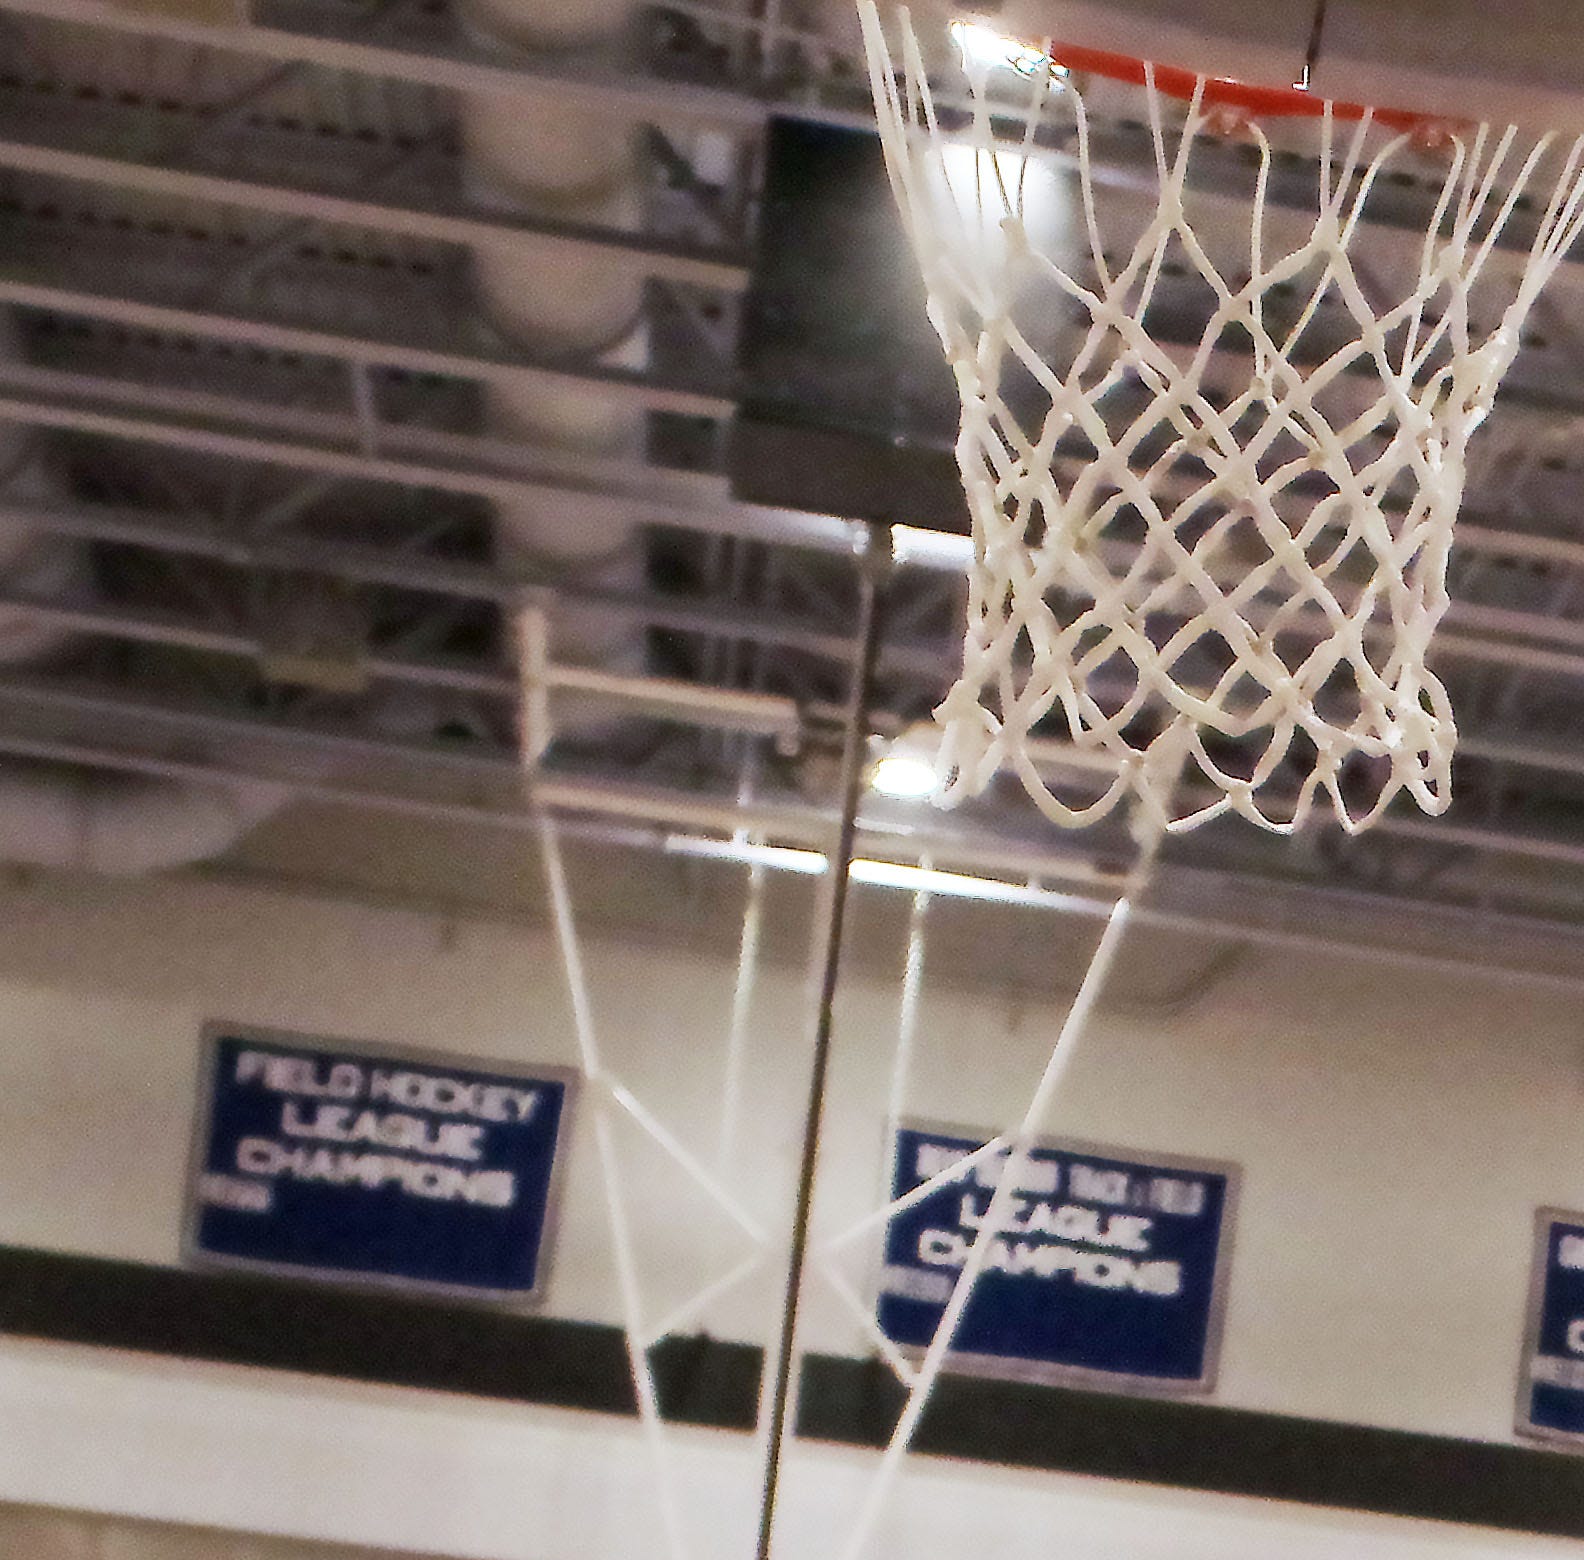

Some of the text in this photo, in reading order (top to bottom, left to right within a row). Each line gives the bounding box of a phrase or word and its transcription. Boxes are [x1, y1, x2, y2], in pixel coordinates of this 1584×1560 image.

[236, 1050, 540, 1123] FIELD HOCKEY
[281, 1102, 484, 1160] LEAGUE
[235, 1136, 514, 1207] CHAMPIONS
[960, 1194, 1152, 1252] LEAGUE
